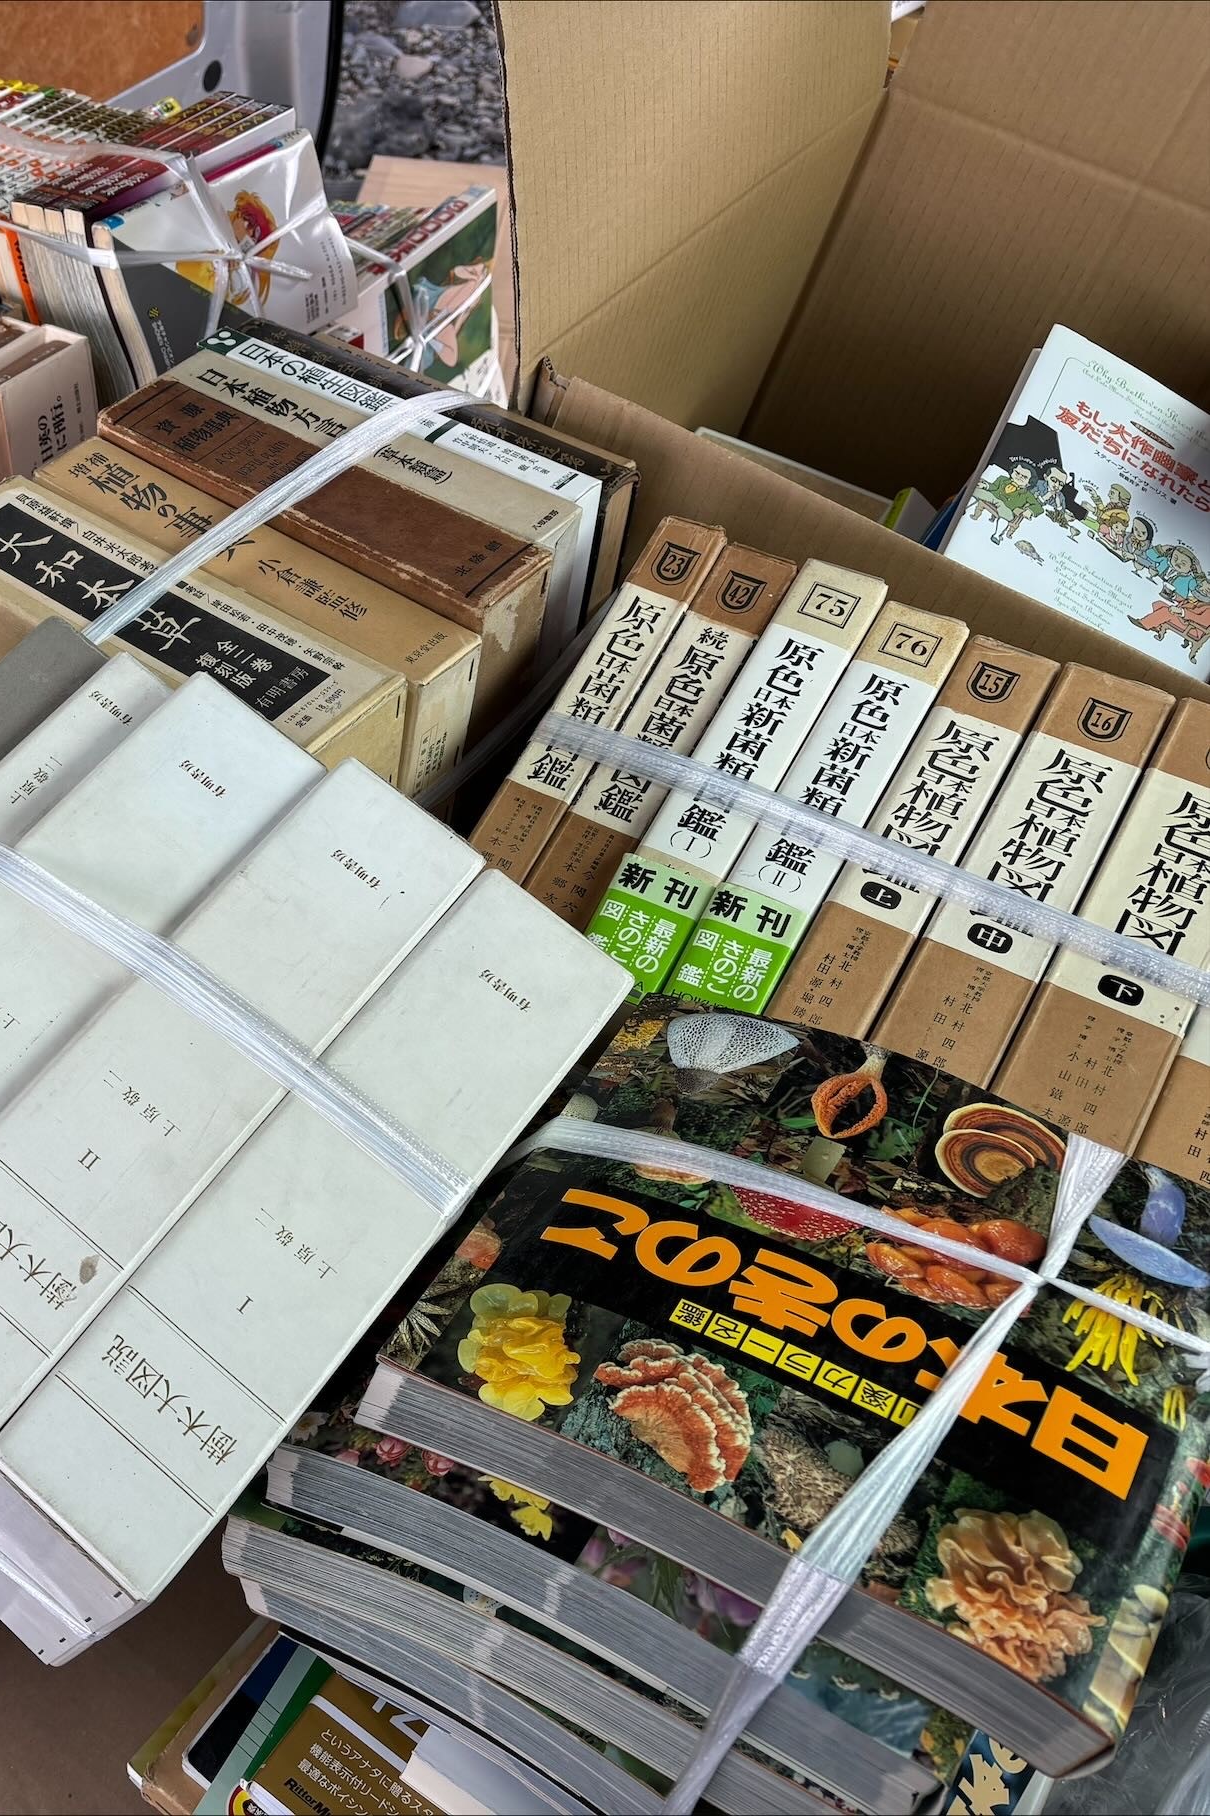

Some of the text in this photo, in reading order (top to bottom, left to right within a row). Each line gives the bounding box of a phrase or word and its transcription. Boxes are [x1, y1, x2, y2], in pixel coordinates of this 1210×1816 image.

[196, 367, 348, 438] 日本植物方言
[239, 343, 394, 413] 日本の植生図鑑
[454, 540, 504, 577] 北隆館
[661, 554, 686, 577] 23
[729, 587, 750, 604] 42
[813, 593, 848, 617] 75
[895, 632, 929, 657] 76
[254, 667, 310, 710] 有明書房
[978, 672, 1001, 694] 15
[677, 637, 825, 843] 原色日本新菌類鑑
[1090, 711, 1113, 732] 16
[10, 755, 63, 804] 上原敬二
[178, 759, 226, 800] 有明書房
[764, 672, 910, 877] 原色日本新菌類鑑
[862, 720, 1000, 894] 原色日本植物図
[331, 847, 382, 891] 有明書房
[969, 748, 1113, 938] 原色日本植物図
[618, 860, 699, 910] 新刊
[610, 911, 650, 964] きのこ
[709, 889, 792, 938] 新刊
[976, 927, 1006, 949] 中
[634, 918, 678, 974] 最新の
[676, 928, 720, 988] 図鑑
[706, 940, 744, 995] きのこ
[478, 968, 532, 1013] 有明書房
[732, 948, 773, 1002] 最新の
[808, 961, 853, 1025] 北村四郎
[1108, 977, 1138, 1000] 下
[103, 1069, 182, 1137] 上原敬二
[1058, 1057, 1098, 1128] 村田源
[1074, 1058, 1114, 1135] 北村四郎
[255, 1207, 339, 1280] 上原敬二
[540, 1187, 1150, 1502] 日本のきのこ
[97, 1332, 237, 1467] 樹木大図説
